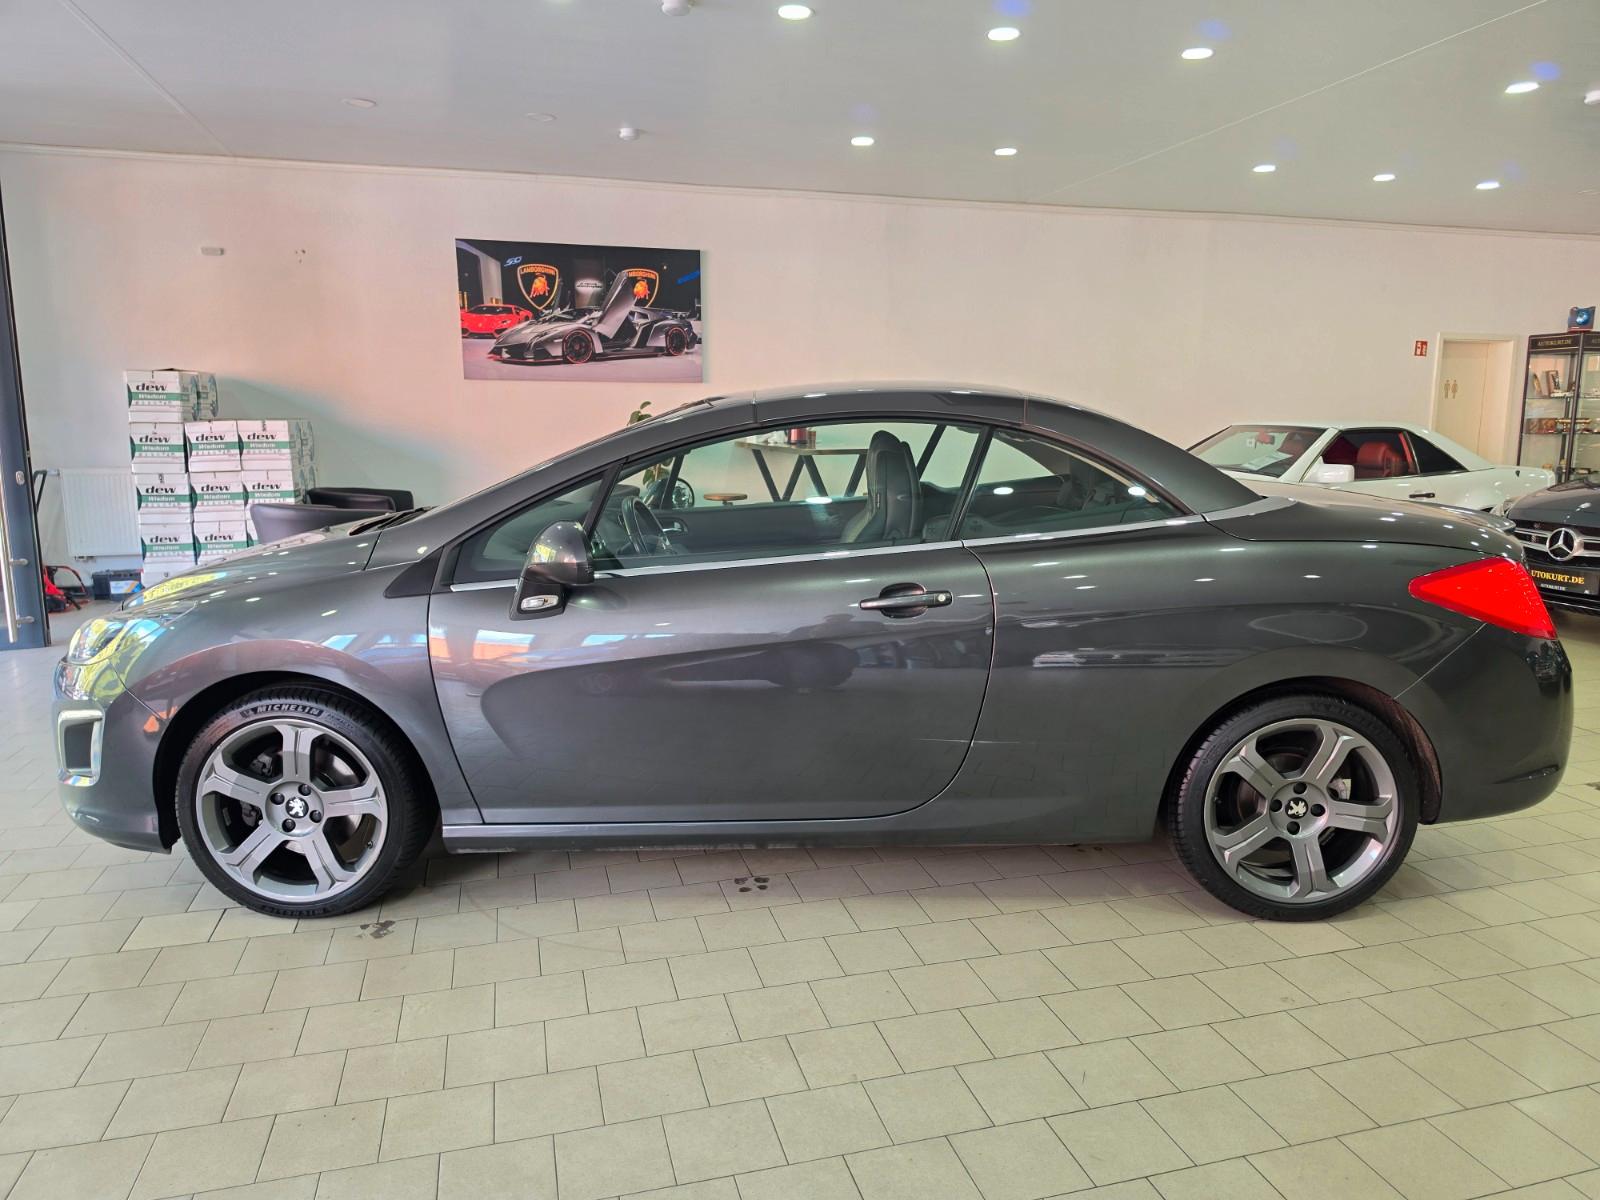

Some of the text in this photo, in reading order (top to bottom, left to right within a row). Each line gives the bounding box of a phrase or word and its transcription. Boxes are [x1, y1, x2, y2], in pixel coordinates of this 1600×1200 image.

[136, 383, 167, 391] dew
[139, 435, 171, 443] dew
[195, 433, 226, 441] dew
[247, 432, 277, 440] dew
[145, 485, 177, 494] dew
[201, 484, 231, 492] dew
[252, 482, 282, 490] dew
[150, 534, 181, 543] dew
[204, 533, 234, 542] dew
[1531, 570, 1585, 585] UTOKURT.DE
[257, 703, 321, 716] MICHELIN
